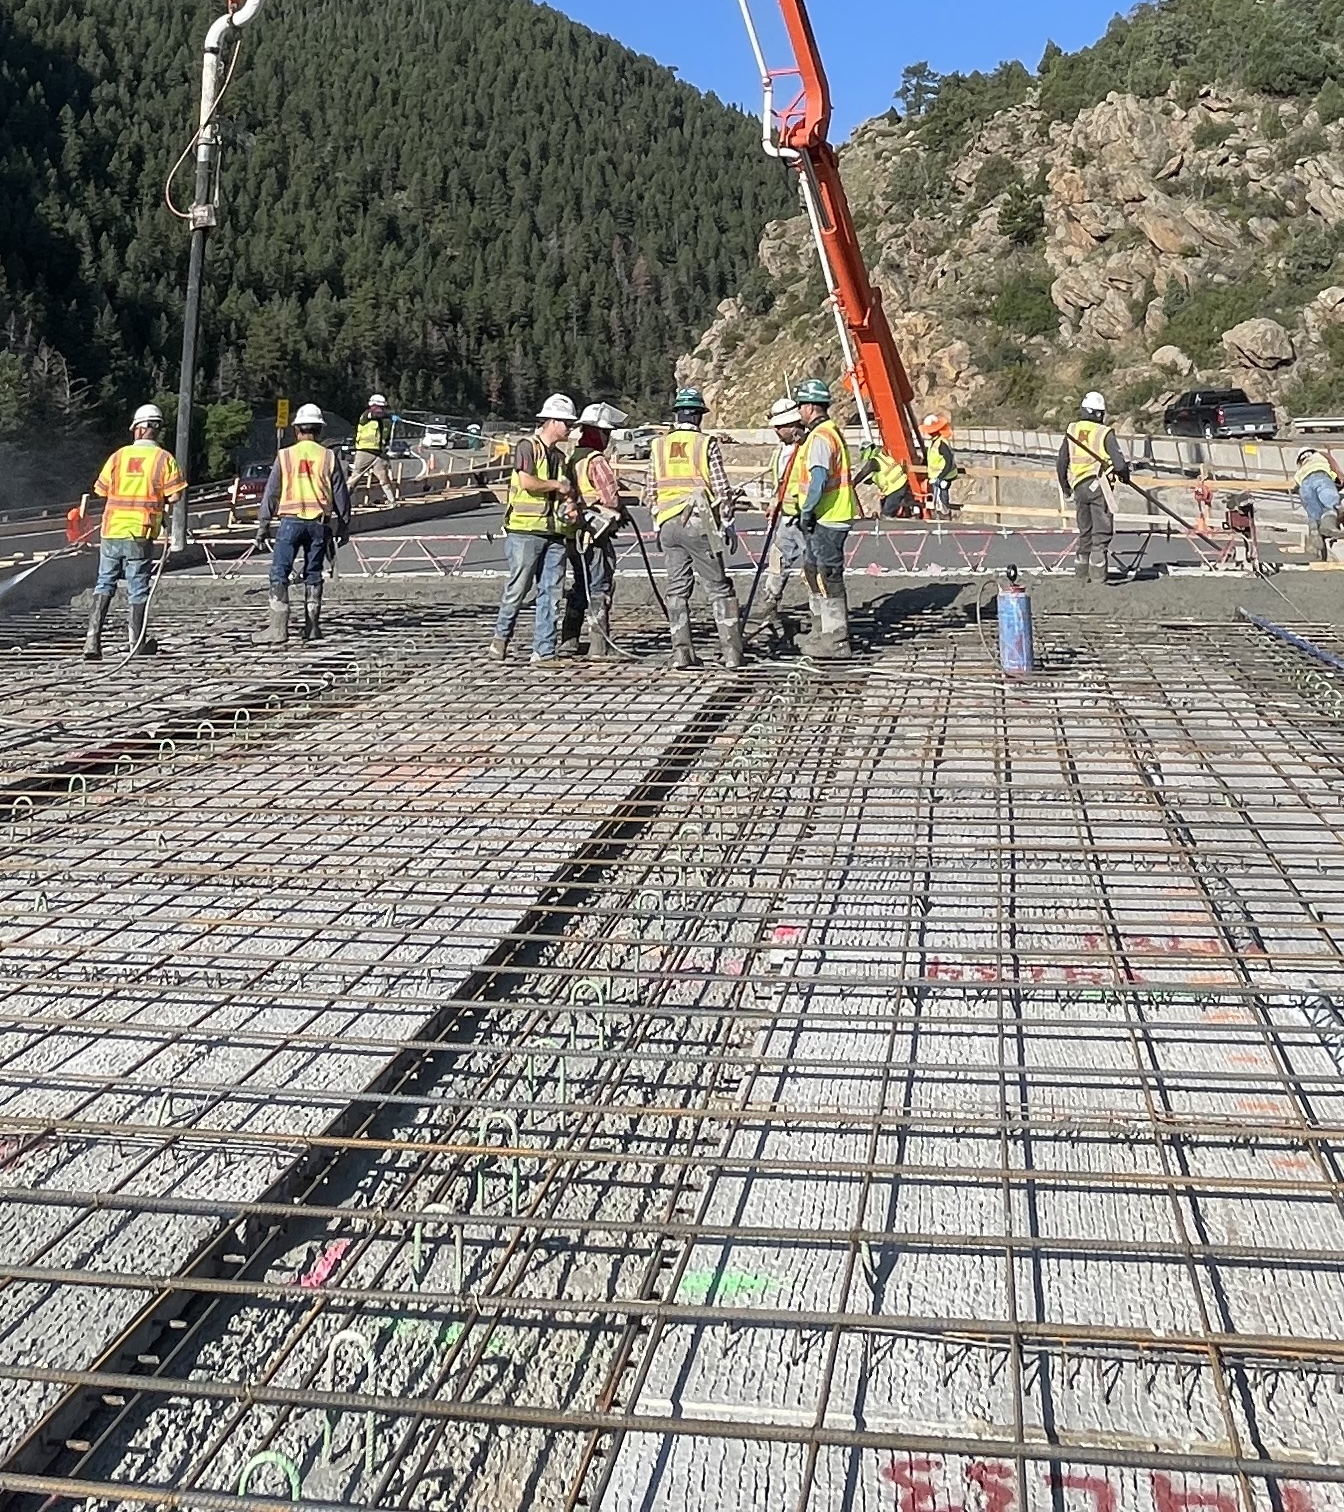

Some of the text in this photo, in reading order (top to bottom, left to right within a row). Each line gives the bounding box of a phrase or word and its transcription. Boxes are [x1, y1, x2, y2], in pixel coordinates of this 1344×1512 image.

[670, 441, 688, 459] K
[127, 457, 147, 474] K
[298, 459, 315, 475] K
